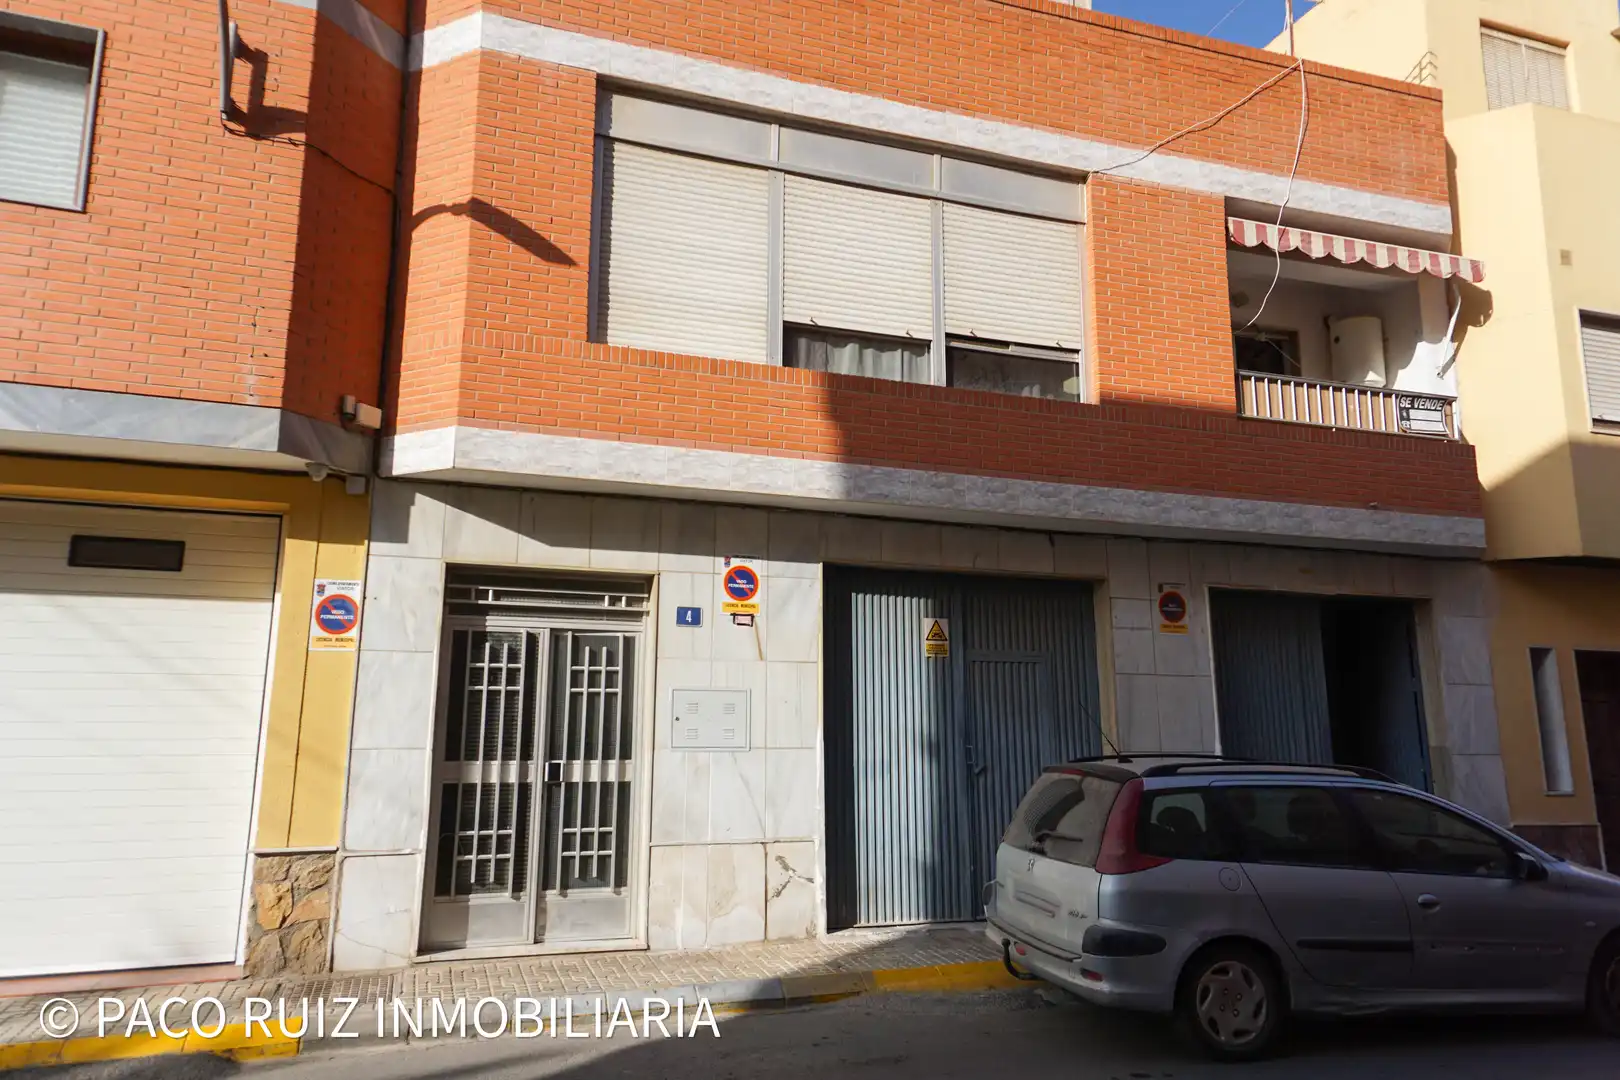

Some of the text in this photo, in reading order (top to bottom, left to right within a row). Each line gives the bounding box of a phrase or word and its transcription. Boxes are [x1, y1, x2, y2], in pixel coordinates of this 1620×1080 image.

[1400, 397, 1444, 410] SE VENDE
[685, 610, 692, 623] 4
